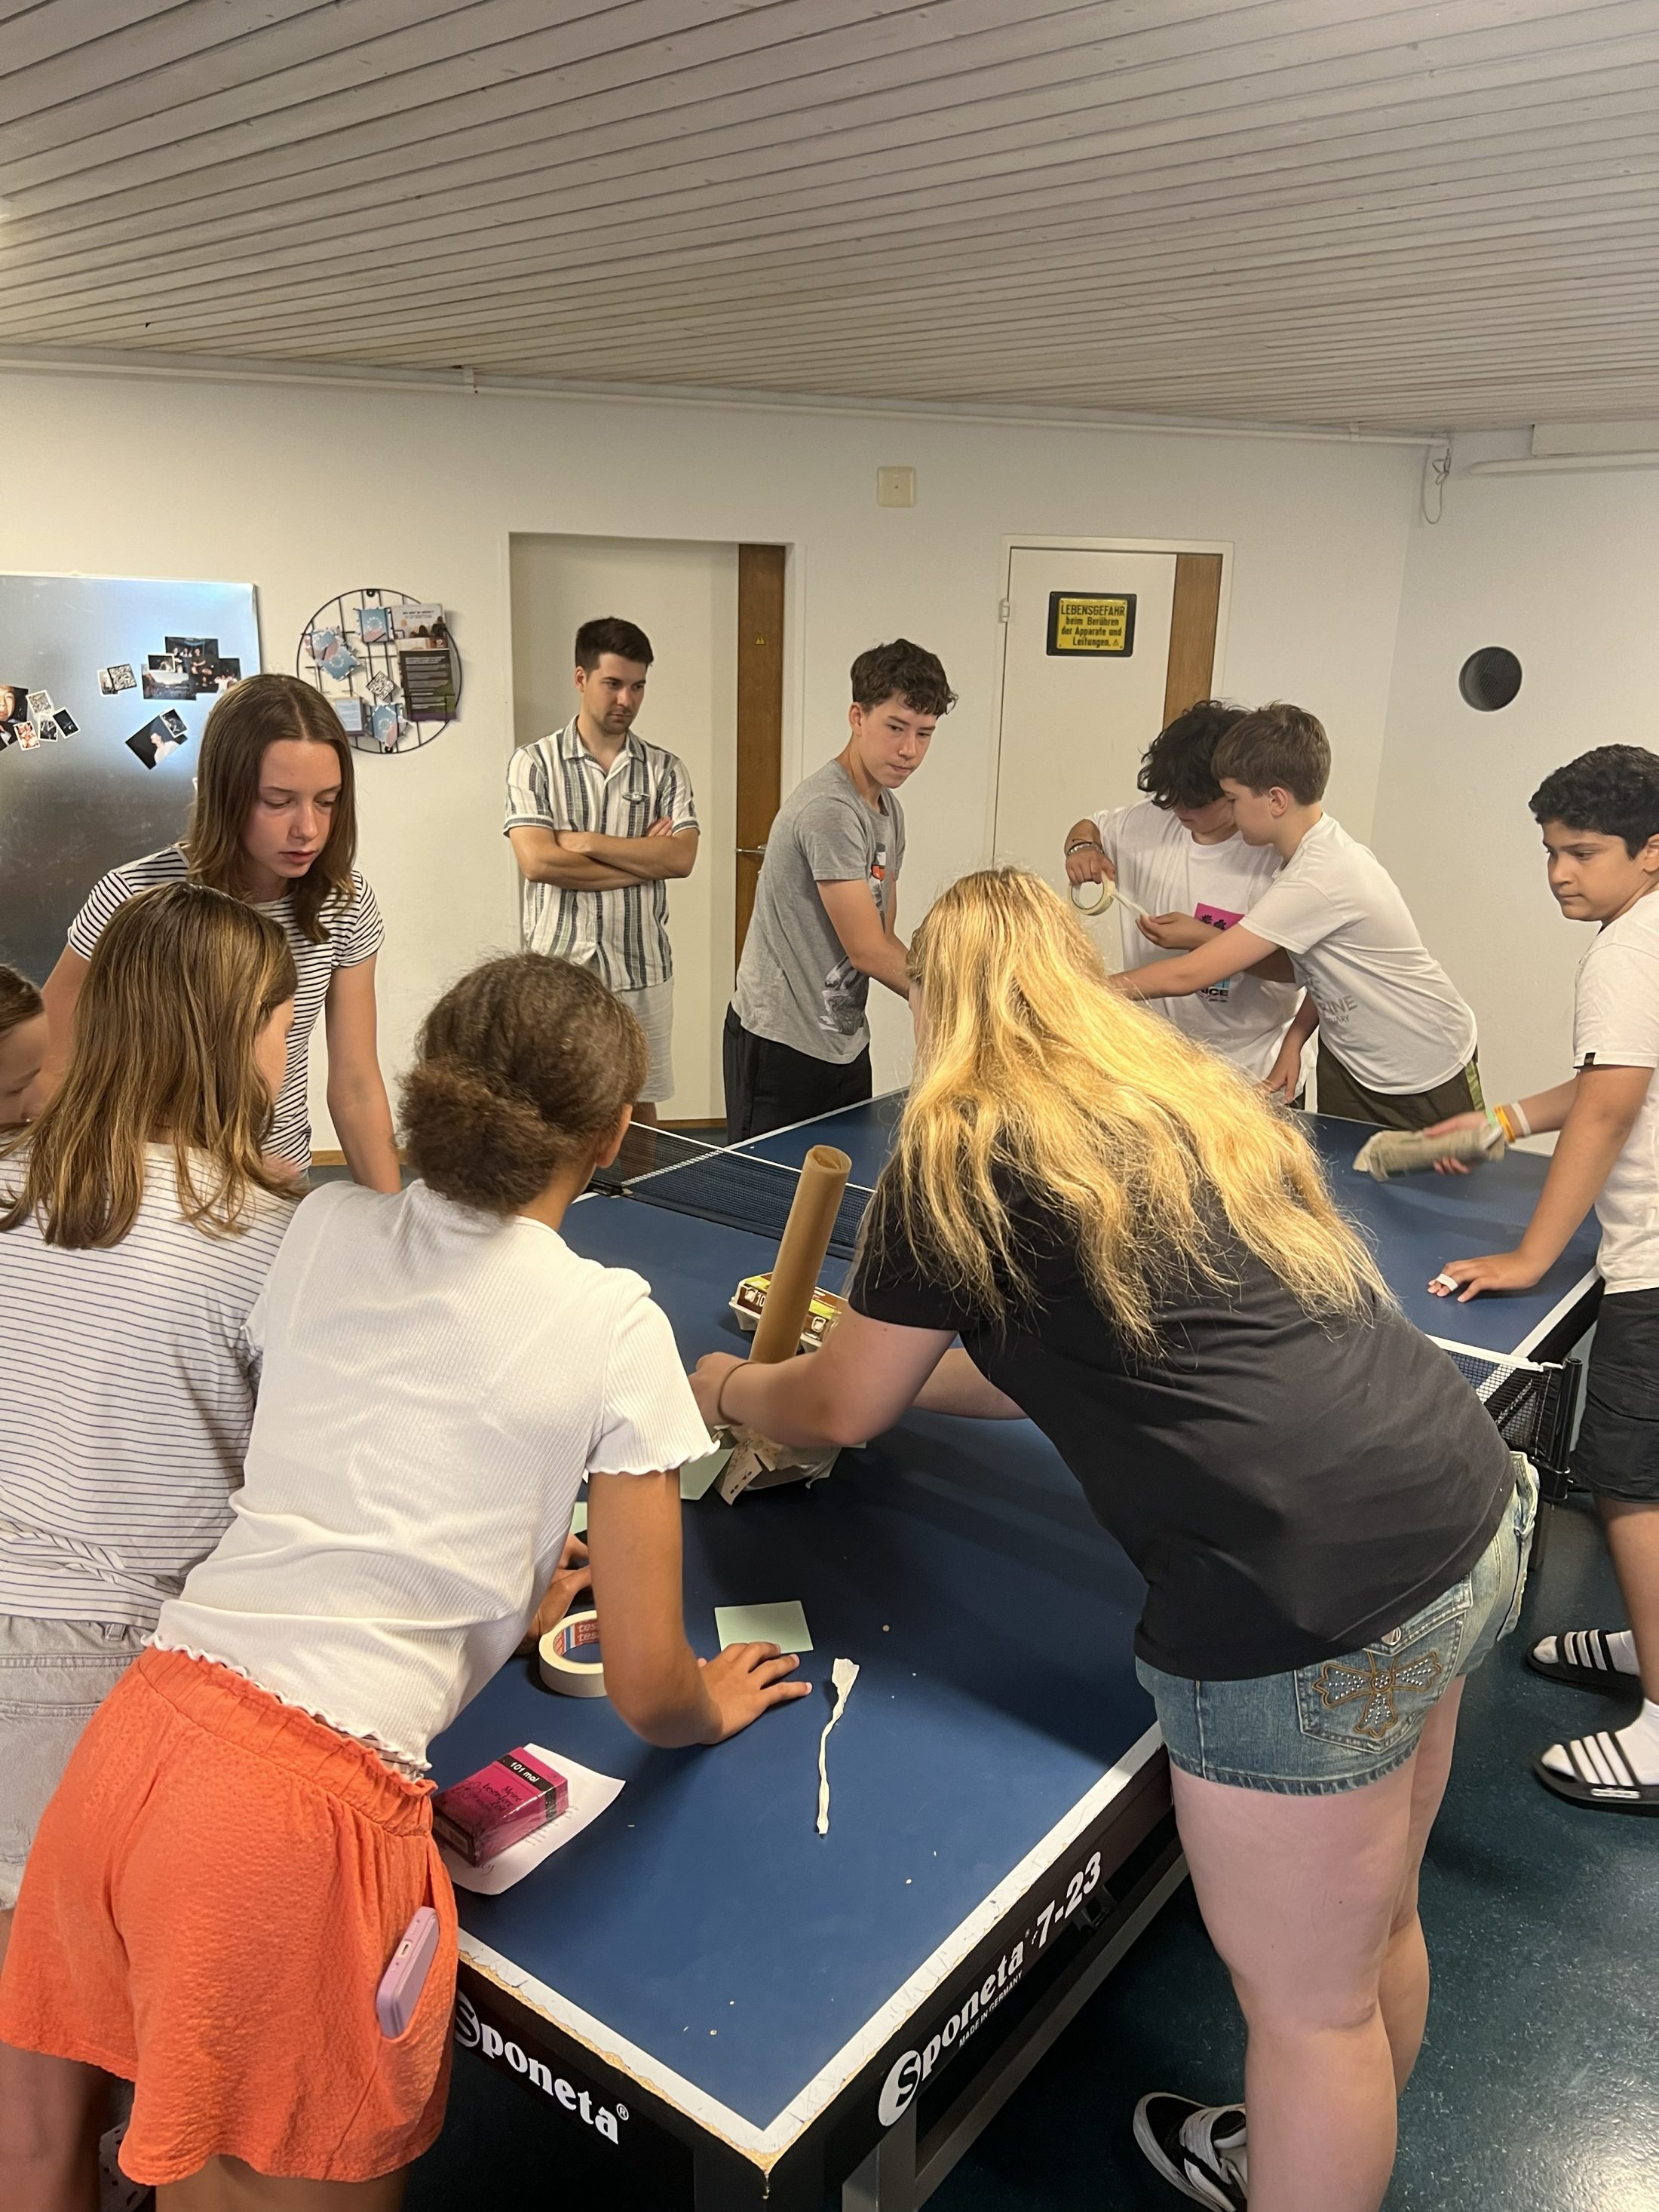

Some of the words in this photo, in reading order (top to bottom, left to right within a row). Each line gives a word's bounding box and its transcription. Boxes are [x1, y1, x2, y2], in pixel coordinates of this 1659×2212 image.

[1061, 604, 1125, 616] LEBENSGEFAHR
[1066, 616, 1084, 625] beim
[1087, 616, 1119, 626] Berühren
[1061, 626, 1072, 635] der
[1075, 627, 1106, 637] Apparate
[1109, 627, 1122, 636] und
[1073, 637, 1111, 648] Leitungen.
[578, 1623, 598, 1633] tes
[578, 1631, 599, 1642] tes
[510, 1762, 526, 1772] 101
[523, 1772, 540, 1783] mal
[879, 1941, 1024, 2126] Sponeta
[1037, 1852, 1101, 1948] 7-23
[959, 2018, 980, 2048] MADE
[981, 2009, 988, 2023] IN
[989, 1970, 1023, 2012] GERMANY
